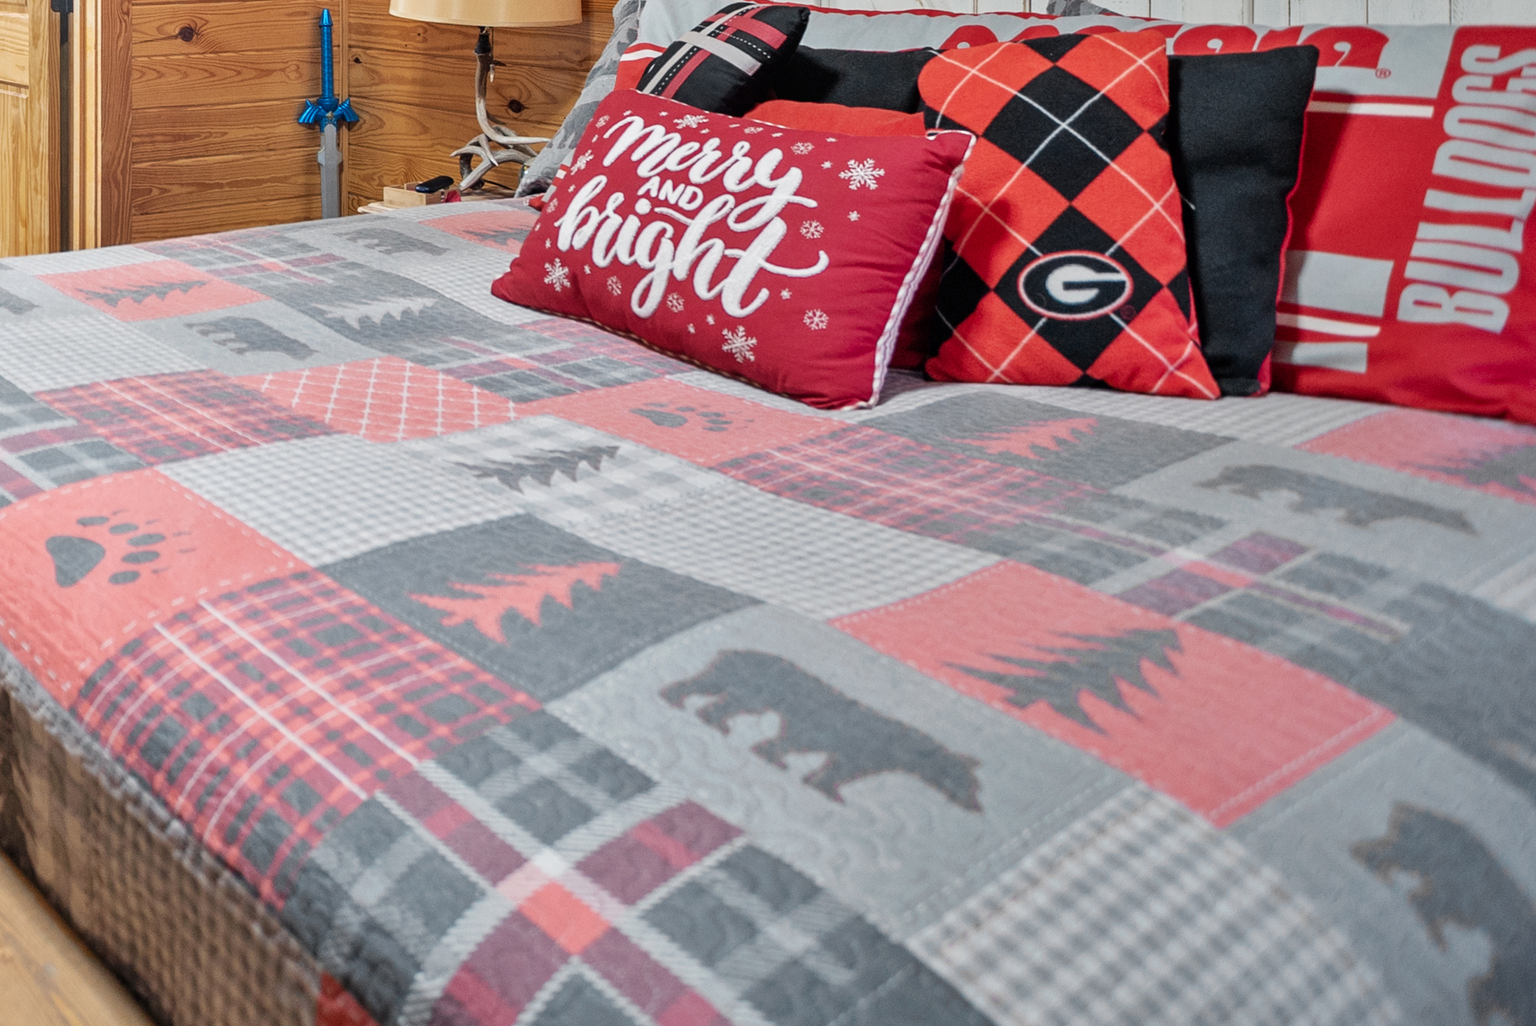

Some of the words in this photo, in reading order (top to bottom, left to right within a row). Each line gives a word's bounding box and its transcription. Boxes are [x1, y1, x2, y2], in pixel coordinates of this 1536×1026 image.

[637, 176, 704, 211] AND
[1396, 43, 1536, 335] BULLDOGS
[553, 174, 830, 319] bright
[1020, 253, 1130, 317] G
